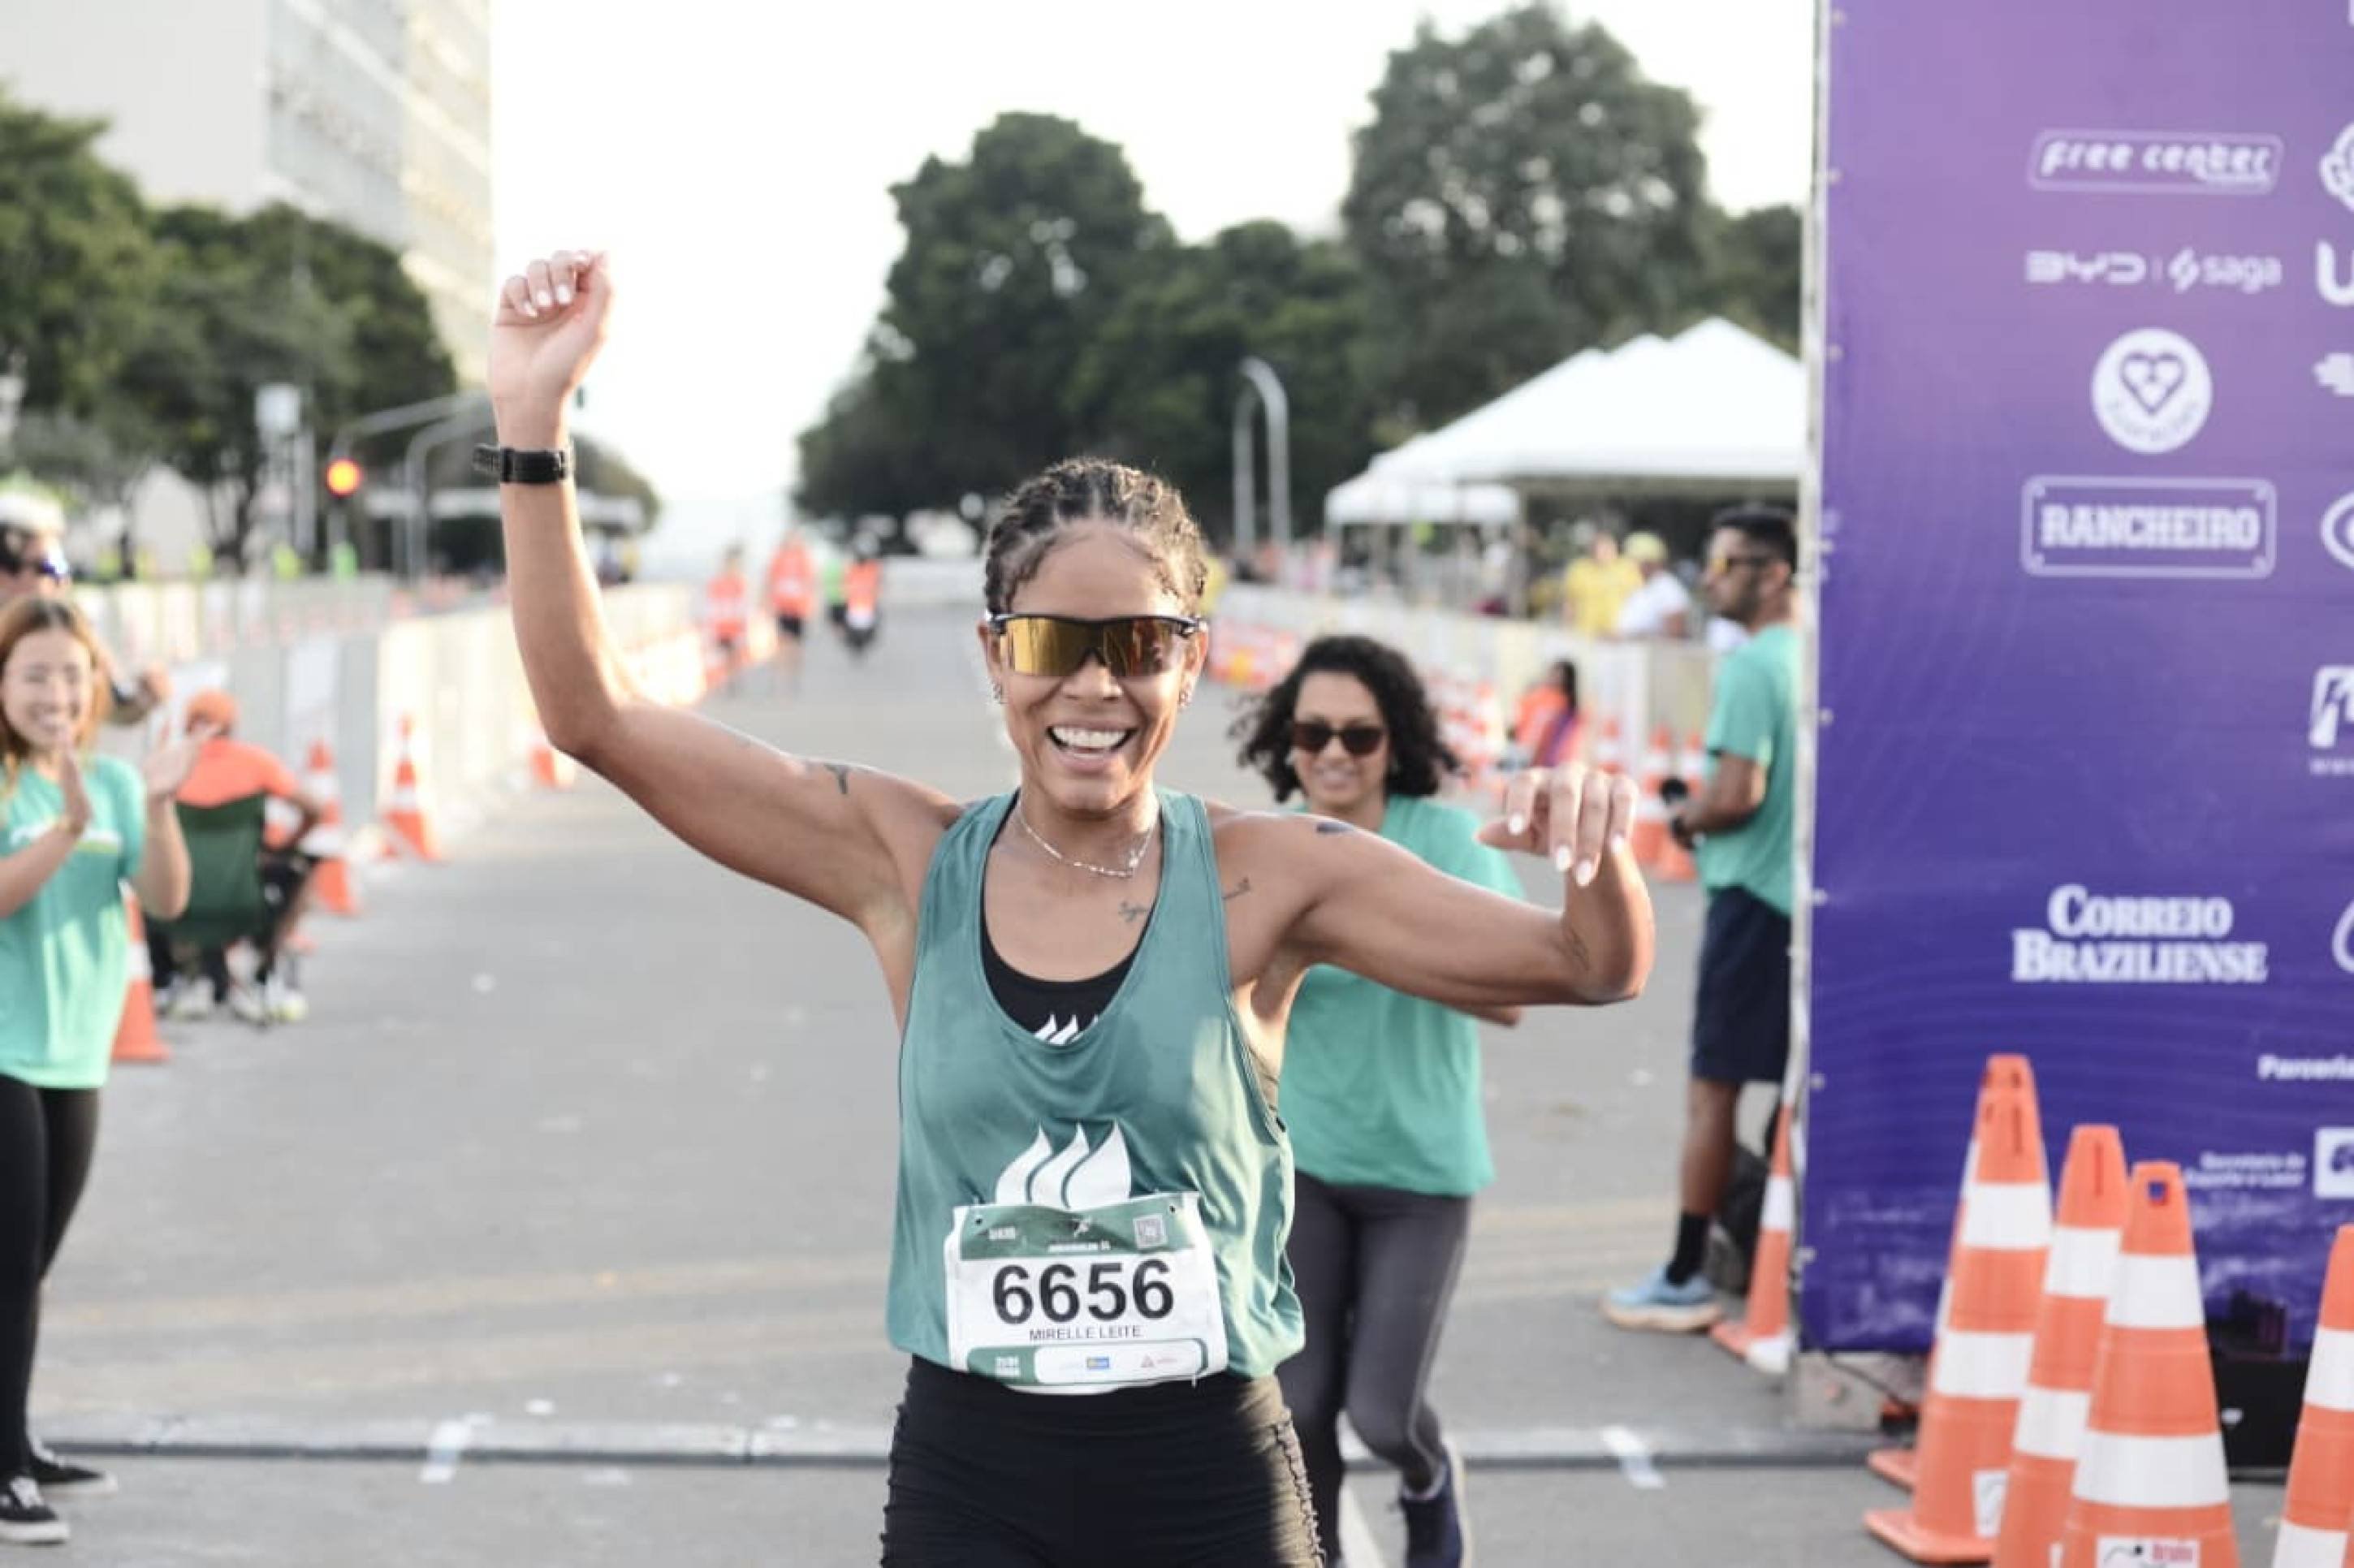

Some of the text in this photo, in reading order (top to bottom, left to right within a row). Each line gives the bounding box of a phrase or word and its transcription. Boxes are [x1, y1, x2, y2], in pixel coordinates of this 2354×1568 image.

[2040, 140, 2272, 182] free center
[2026, 250, 2283, 294] BYD saga
[2040, 504, 2261, 550] RANCHEIRO
[2047, 883, 2234, 938] CORREIO
[2011, 928, 2269, 982] BRAZILIENSE
[993, 1259, 1174, 1324] 6656
[1029, 1324, 1142, 1341] MIRELLE LEITE
